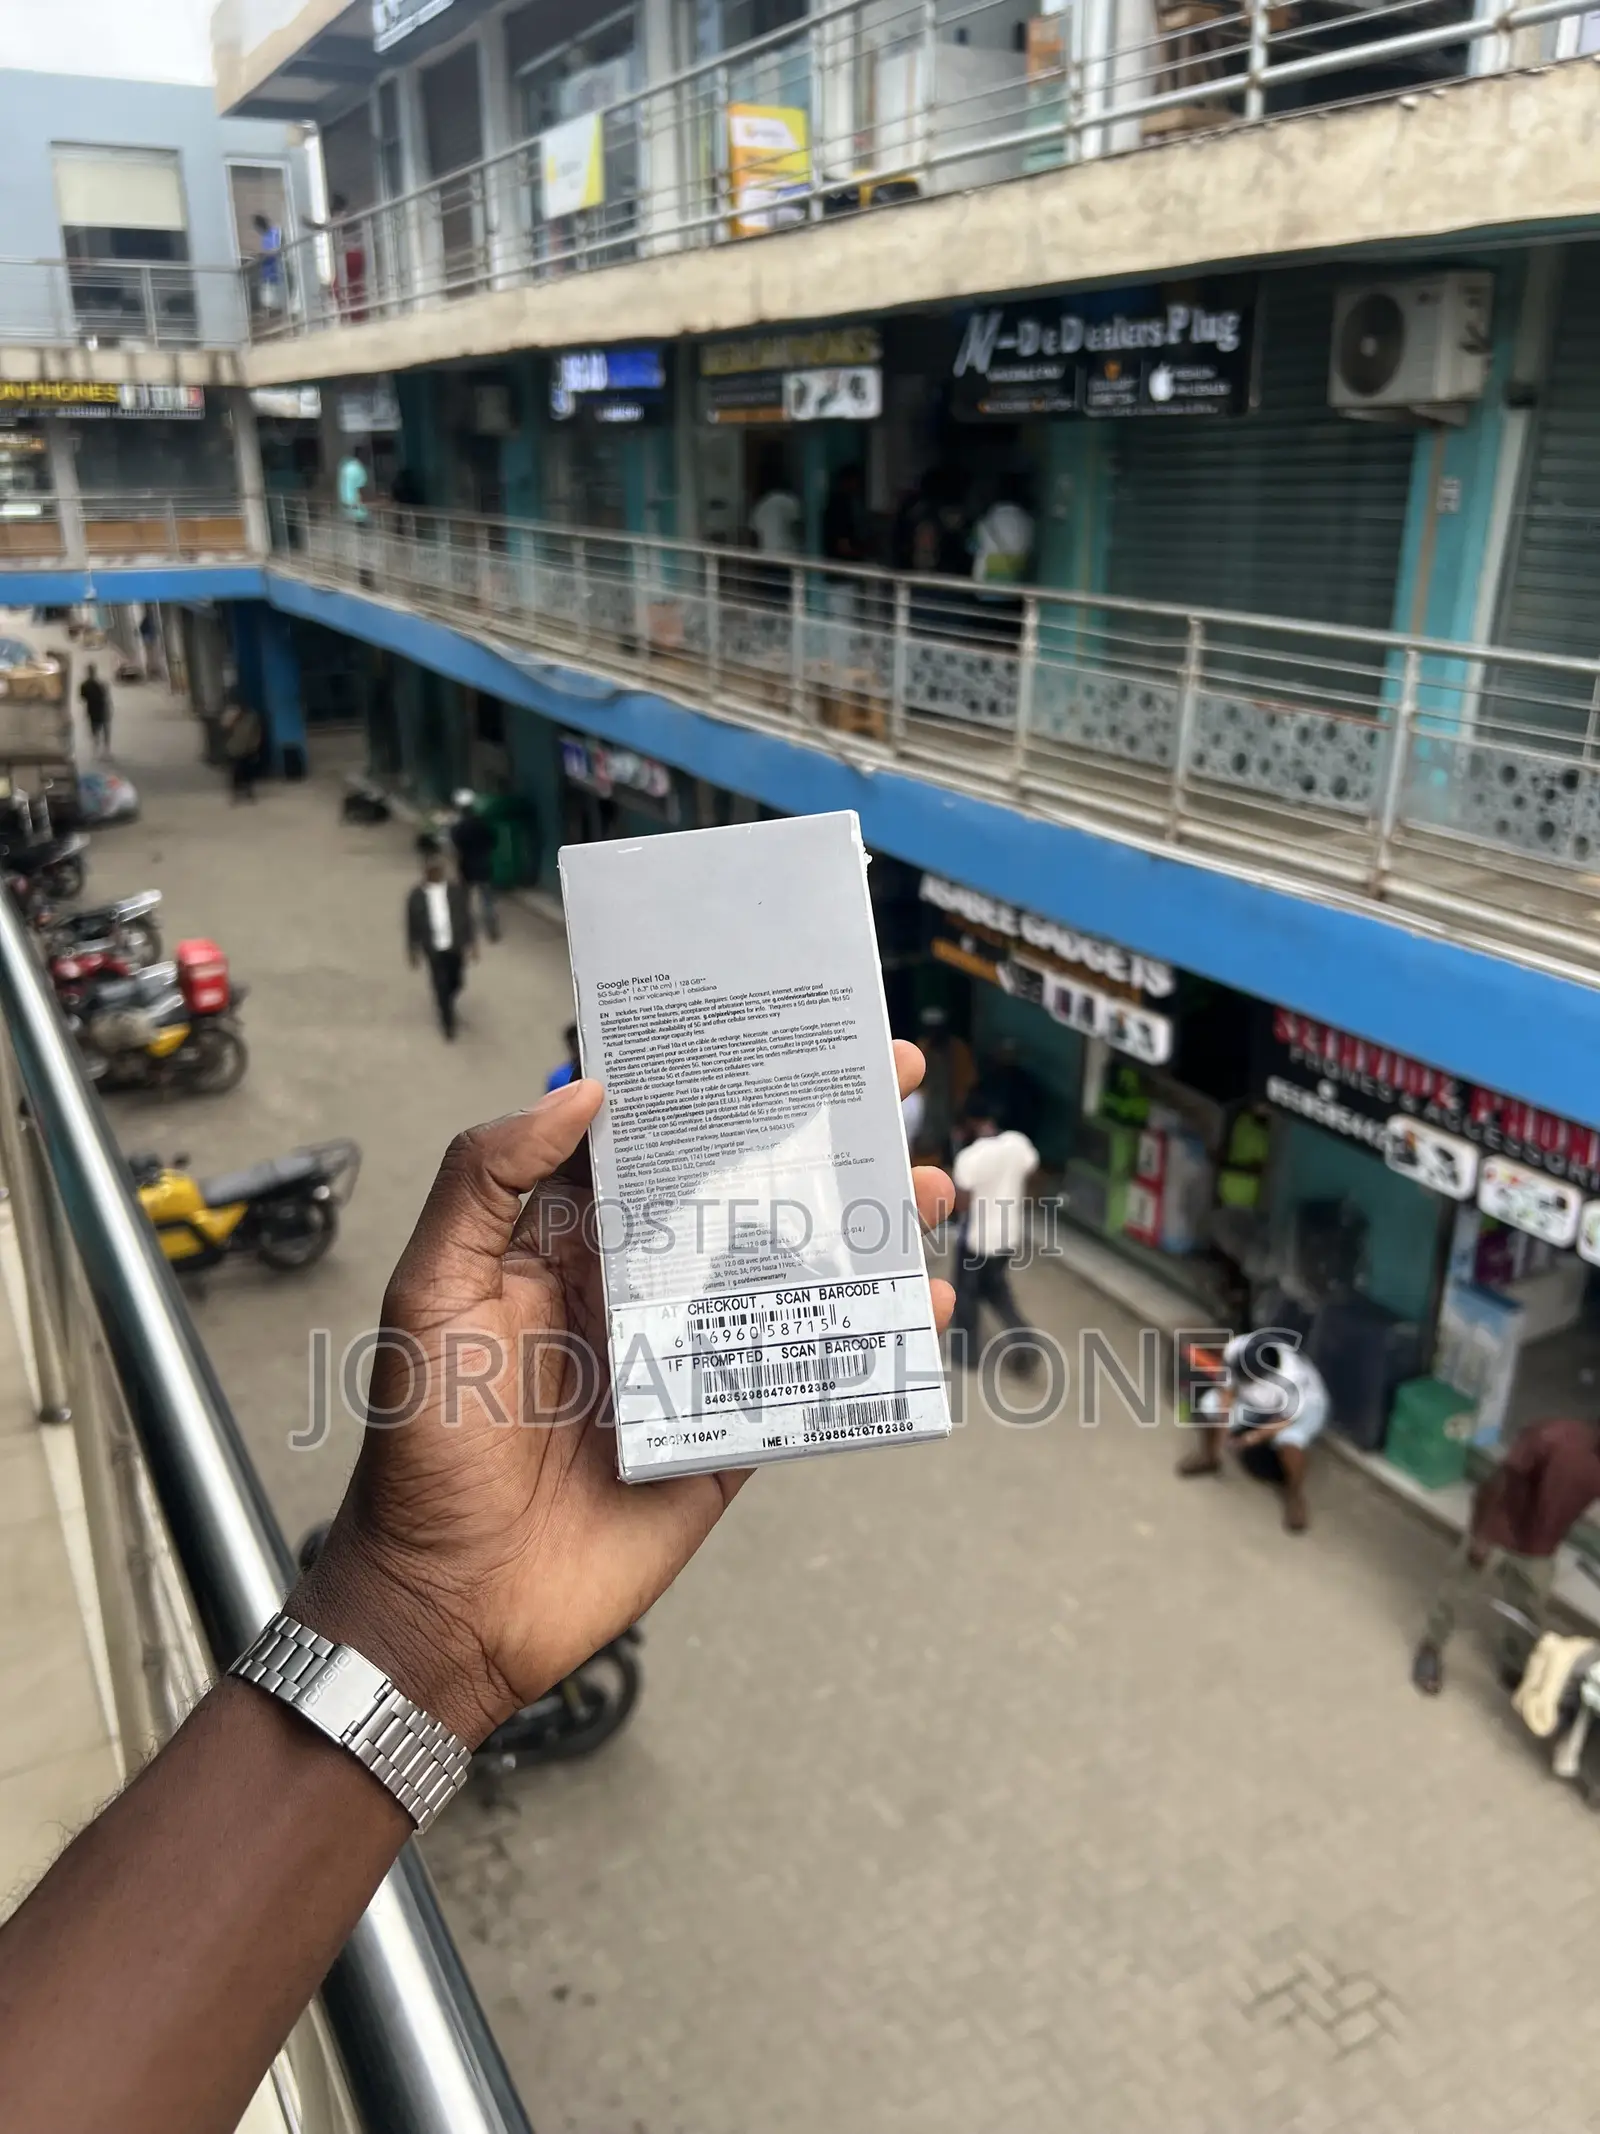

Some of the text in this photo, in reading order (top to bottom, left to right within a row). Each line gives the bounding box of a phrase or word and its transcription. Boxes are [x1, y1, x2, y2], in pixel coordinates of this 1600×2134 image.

[596, 973, 670, 991] Google Pixel 10a
[598, 983, 717, 1006] Obsidian noir volcanique obsidiana
[775, 1289, 811, 1306] SCAN
[819, 1281, 880, 1301] BARCODE
[890, 1280, 897, 1293] 1
[668, 1358, 684, 1373] IF
[781, 1343, 817, 1359] SCAN
[825, 1335, 887, 1355] BARCODE
[896, 1334, 904, 1347] 2
[762, 1434, 797, 1448] IMEI:
[303, 1651, 353, 1707] CASIO
